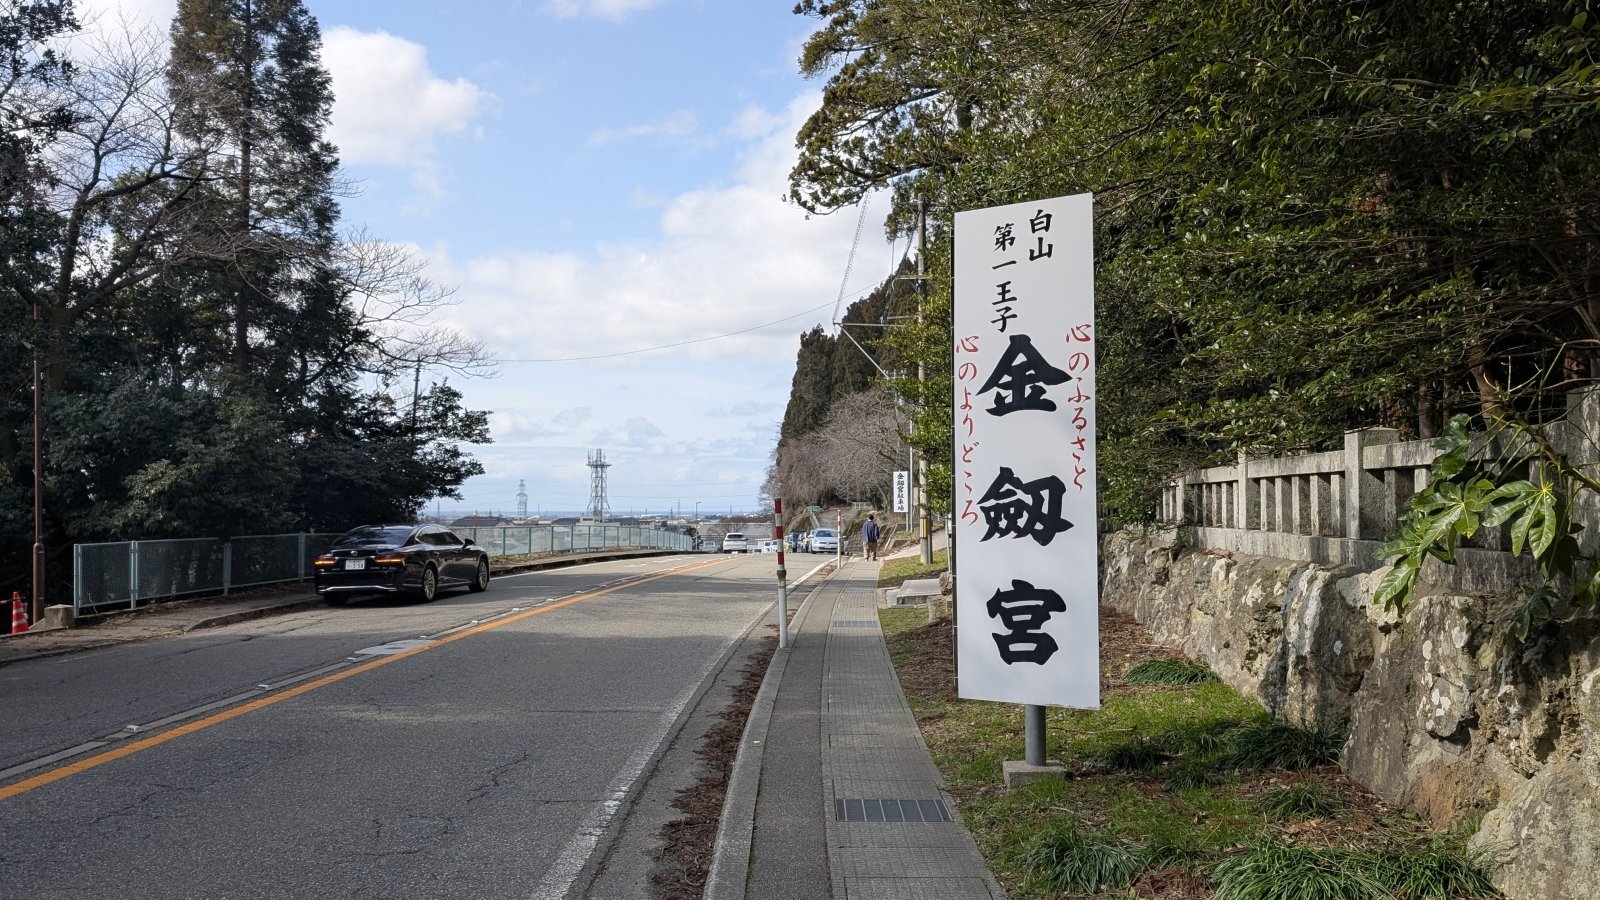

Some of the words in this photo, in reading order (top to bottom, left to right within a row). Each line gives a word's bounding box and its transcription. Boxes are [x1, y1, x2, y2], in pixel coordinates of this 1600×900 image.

[990, 222, 1018, 333] 第一王子
[1028, 209, 1054, 262] 白山
[956, 335, 980, 526] 心のよりどころ
[1065, 323, 1092, 493] 心のふるさと
